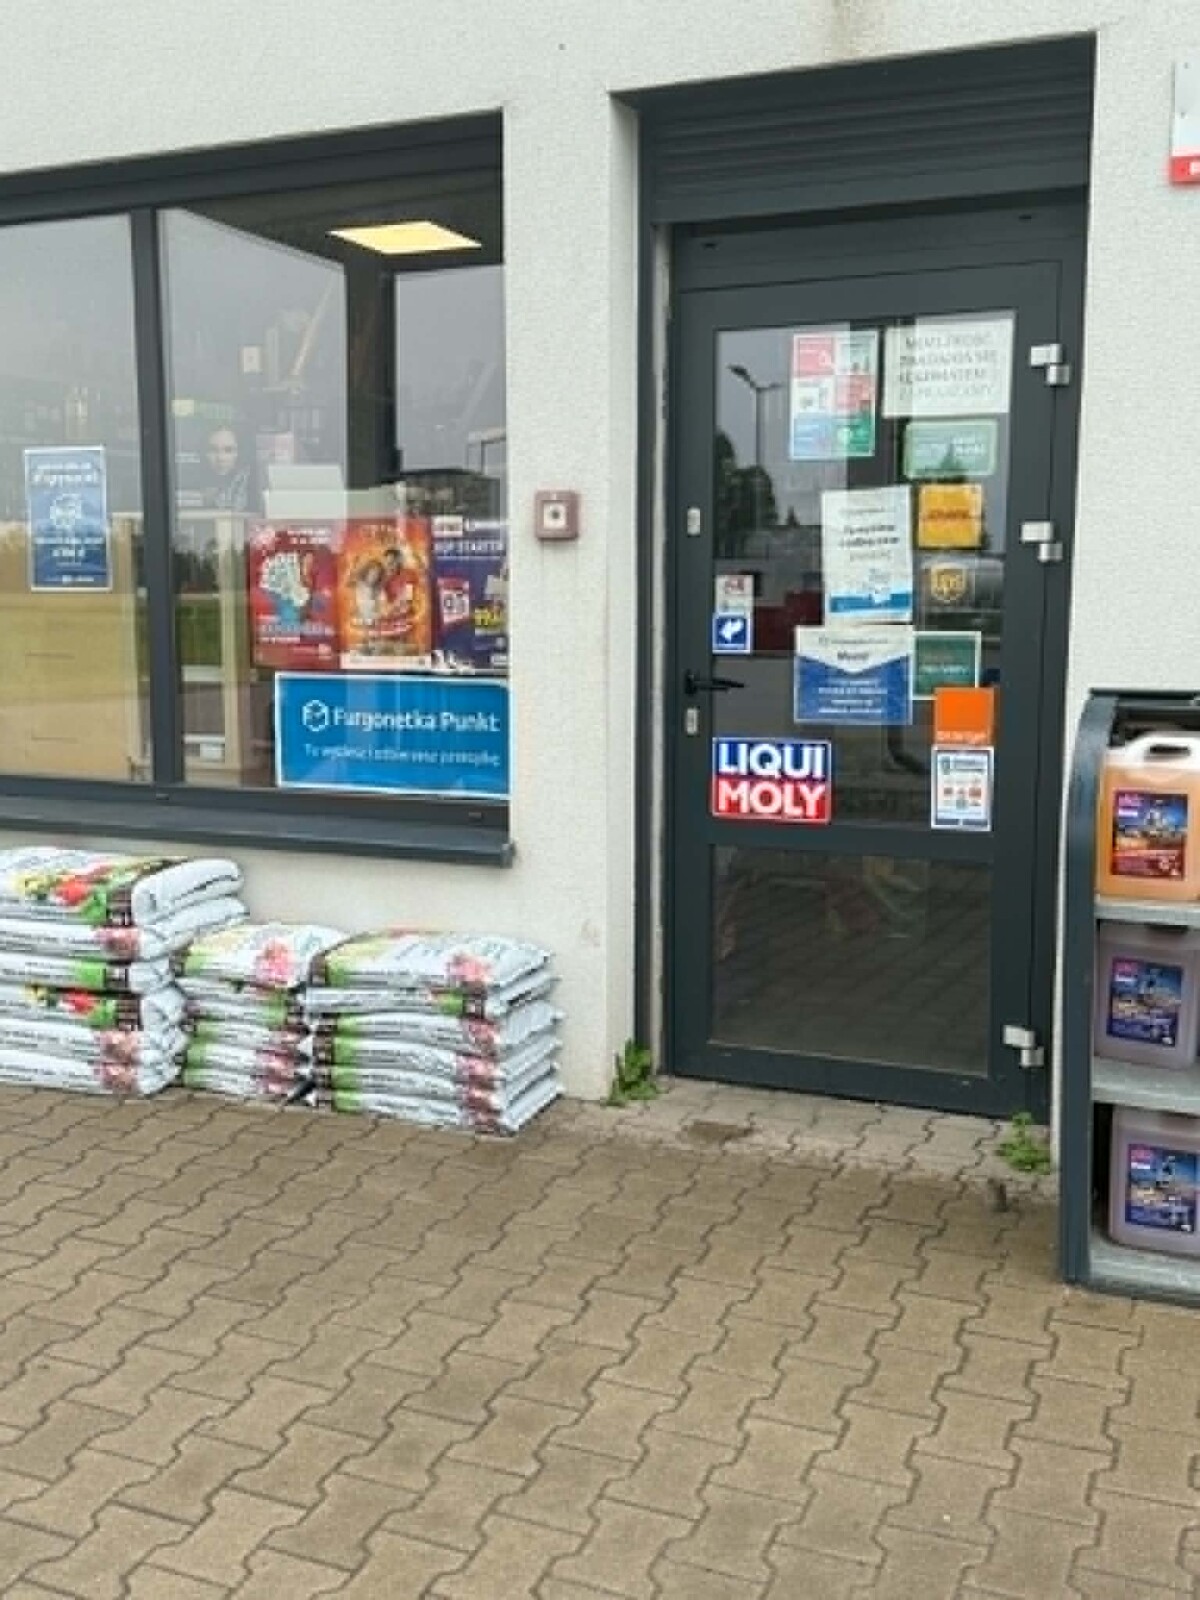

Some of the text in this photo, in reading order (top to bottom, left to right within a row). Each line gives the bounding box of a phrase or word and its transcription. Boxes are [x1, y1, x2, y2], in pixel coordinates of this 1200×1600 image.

[334, 708, 501, 731] Furgonetka Punkt
[718, 743, 825, 778] LIQUI
[718, 783, 826, 819] MOLY
